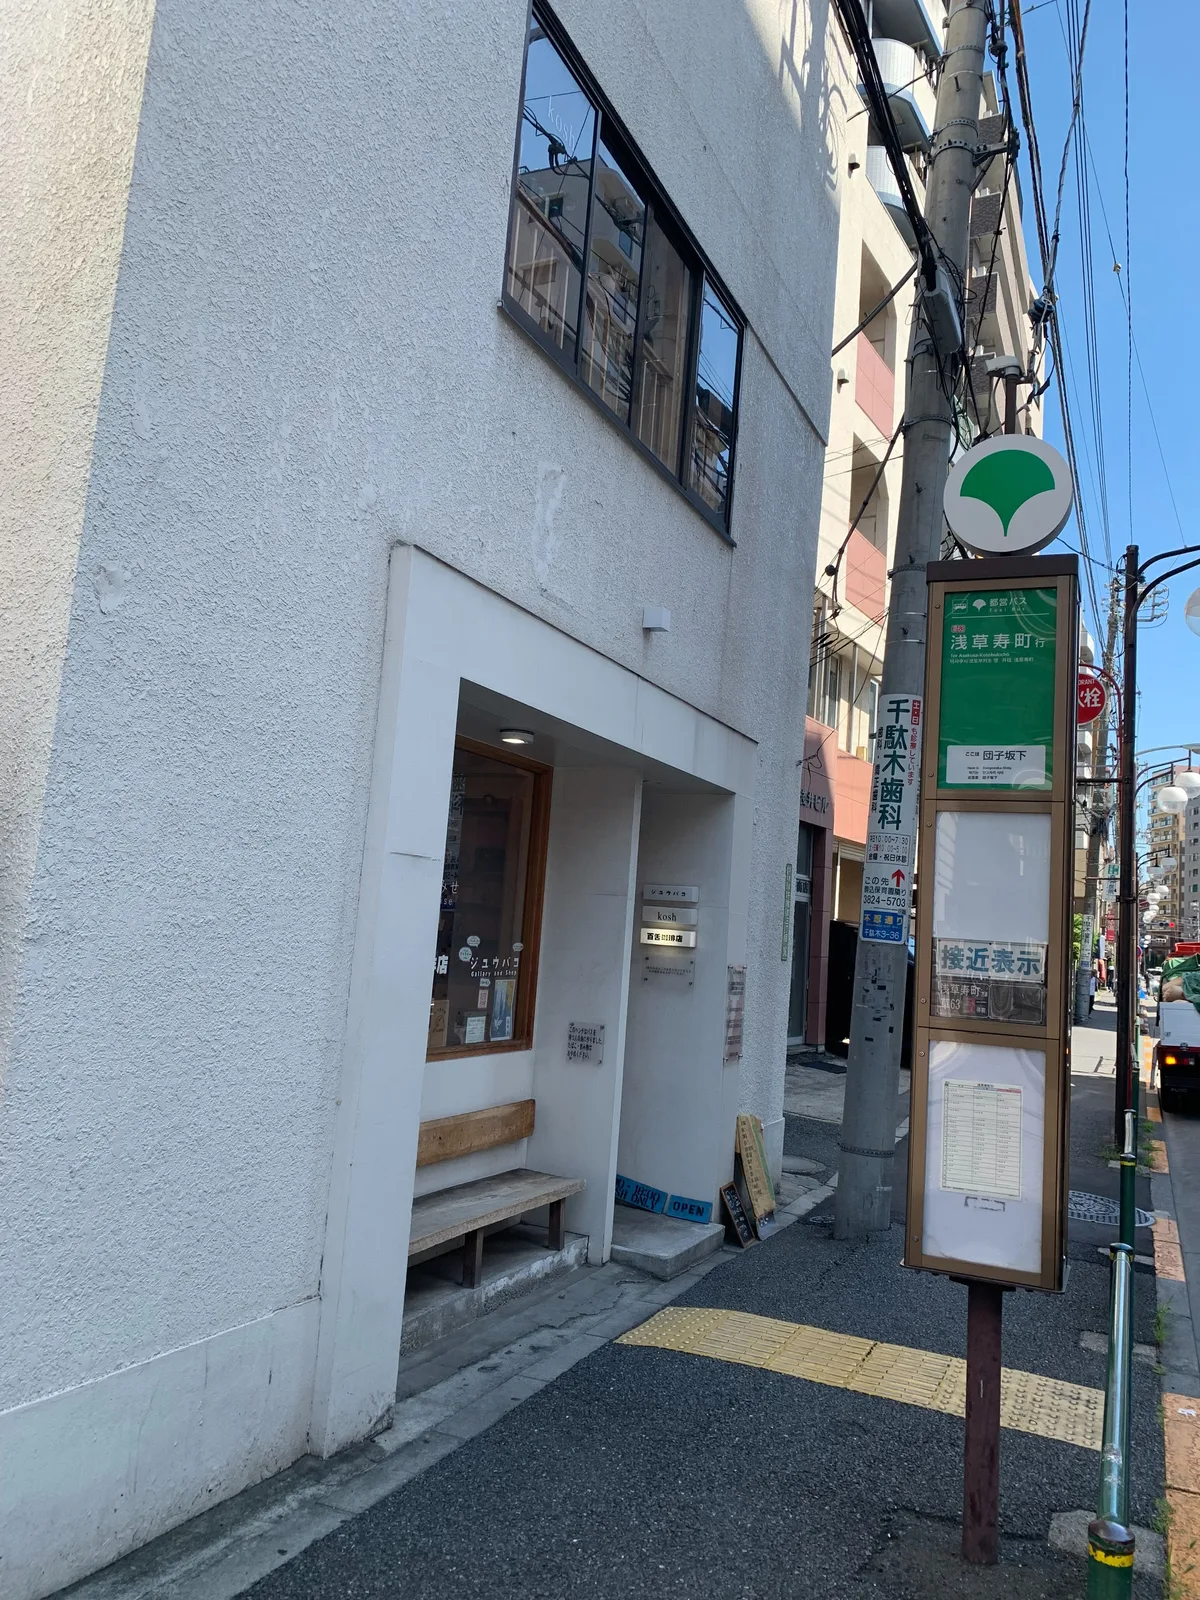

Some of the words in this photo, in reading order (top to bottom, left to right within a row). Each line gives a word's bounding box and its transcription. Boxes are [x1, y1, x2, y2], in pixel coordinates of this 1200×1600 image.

[548, 95, 576, 151] kosh
[989, 597, 1027, 607] 都営バス
[951, 633, 1045, 650] 浅草寿町行
[982, 750, 1028, 761] 団子坂下
[877, 699, 910, 831] 千駄木歯科
[864, 876, 890, 886] この先
[863, 895, 906, 908] 3824-5703
[657, 911, 677, 922] kosh
[941, 944, 1041, 976] 接近表示
[631, 1193, 657, 1211] ONLY
[672, 1201, 705, 1217] OPEN
